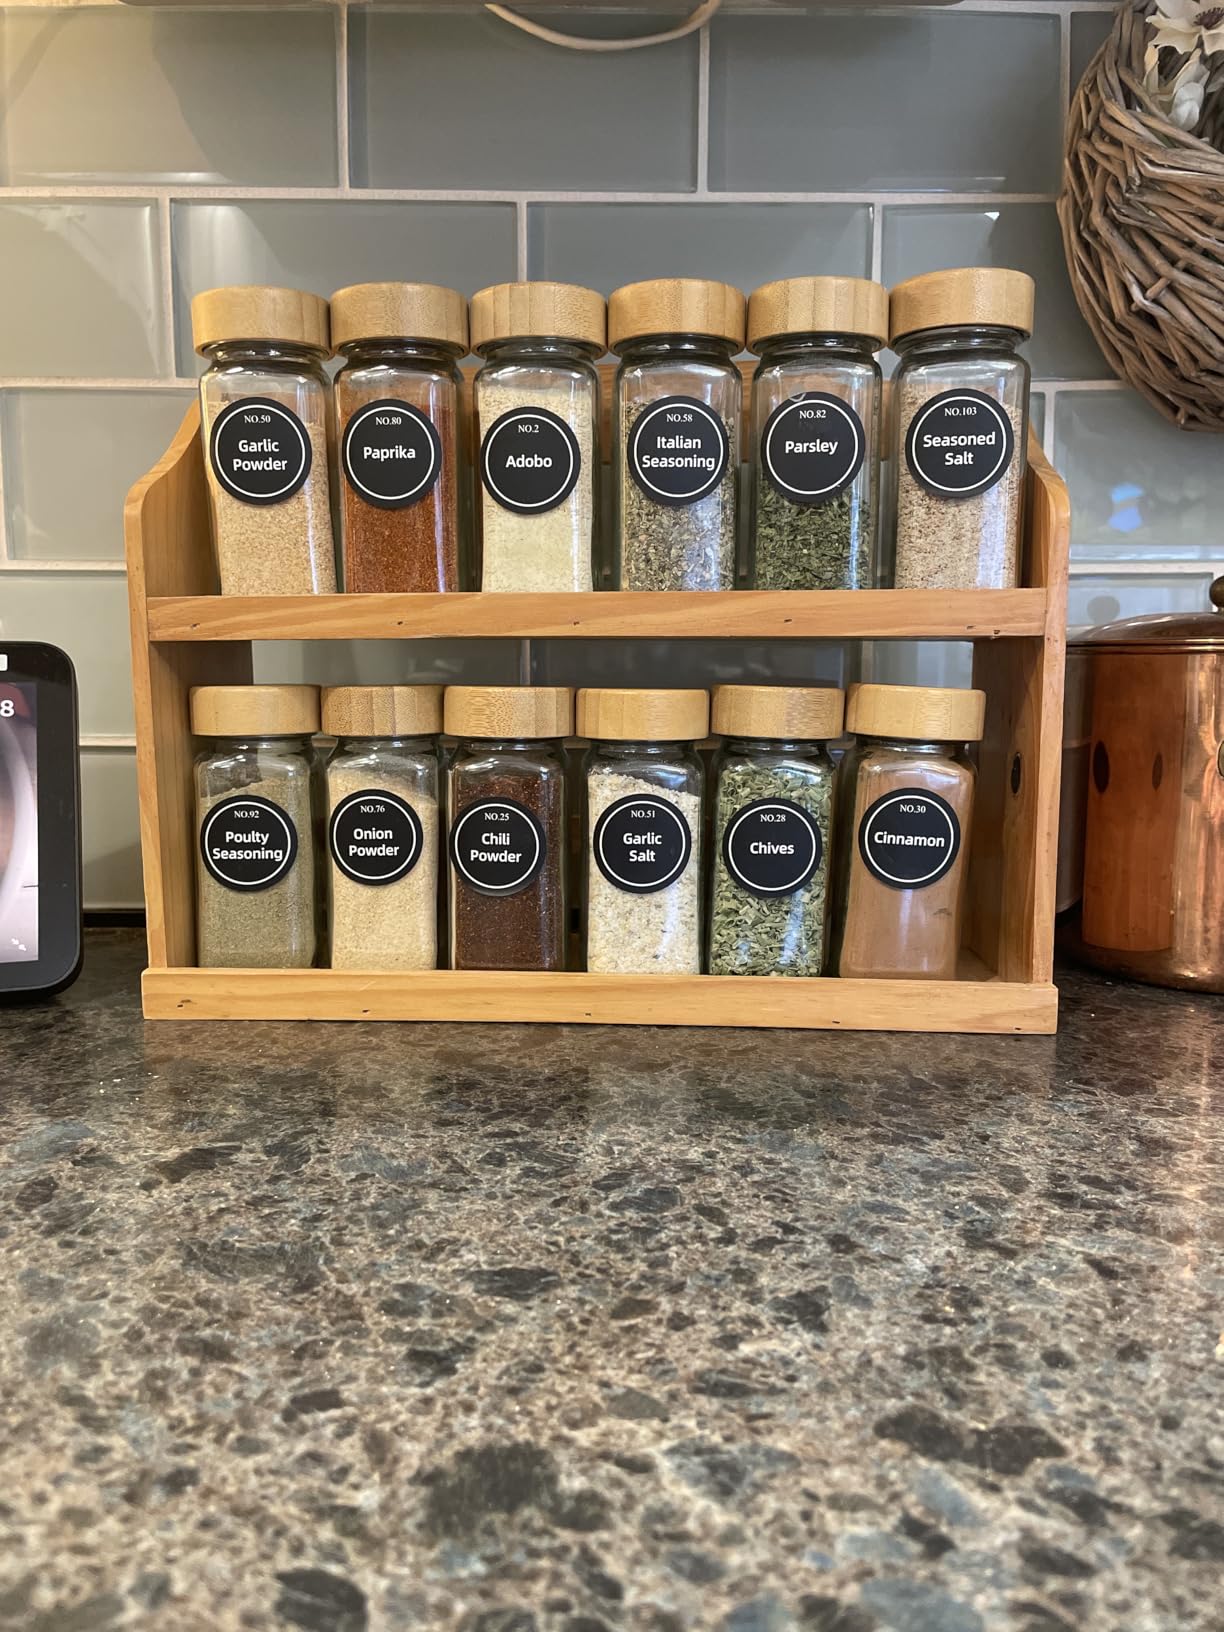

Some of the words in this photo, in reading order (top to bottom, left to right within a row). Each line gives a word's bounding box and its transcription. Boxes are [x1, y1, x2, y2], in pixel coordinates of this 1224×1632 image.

[799, 410, 826, 419] NO.82
[945, 407, 977, 416] NO.103
[244, 415, 271, 423] NO.50
[376, 417, 401, 425] NO.80
[666, 414, 693, 422] NO.58
[518, 424, 539, 433] NO.2
[657, 435, 701, 449] Italian
[923, 431, 995, 447] Seasoned
[239, 439, 279, 452] Garlic
[785, 439, 838, 455] Parsley
[364, 445, 415, 462] Paprika
[945, 451, 974, 465] Salt
[233, 457, 287, 471] Powder
[506, 454, 552, 468] Adobo
[642, 455, 715, 471] Seasoning
[234, 810, 259, 818] NO.92
[360, 805, 385, 813] NO.76
[631, 810, 655, 818] NO.51
[900, 804, 926, 813] NO.30
[485, 813, 509, 821] NO.25
[760, 814, 786, 822] NO.28
[225, 831, 269, 845] Poulty
[354, 828, 393, 840] Onion
[482, 833, 510, 845] Chili
[623, 832, 662, 844] Garlic
[874, 831, 944, 847] Cinnamon
[349, 844, 399, 856] Powder
[750, 842, 794, 854] Chives
[212, 847, 283, 862] Seasoning
[471, 850, 522, 862] Powder
[629, 849, 655, 862] Salt
